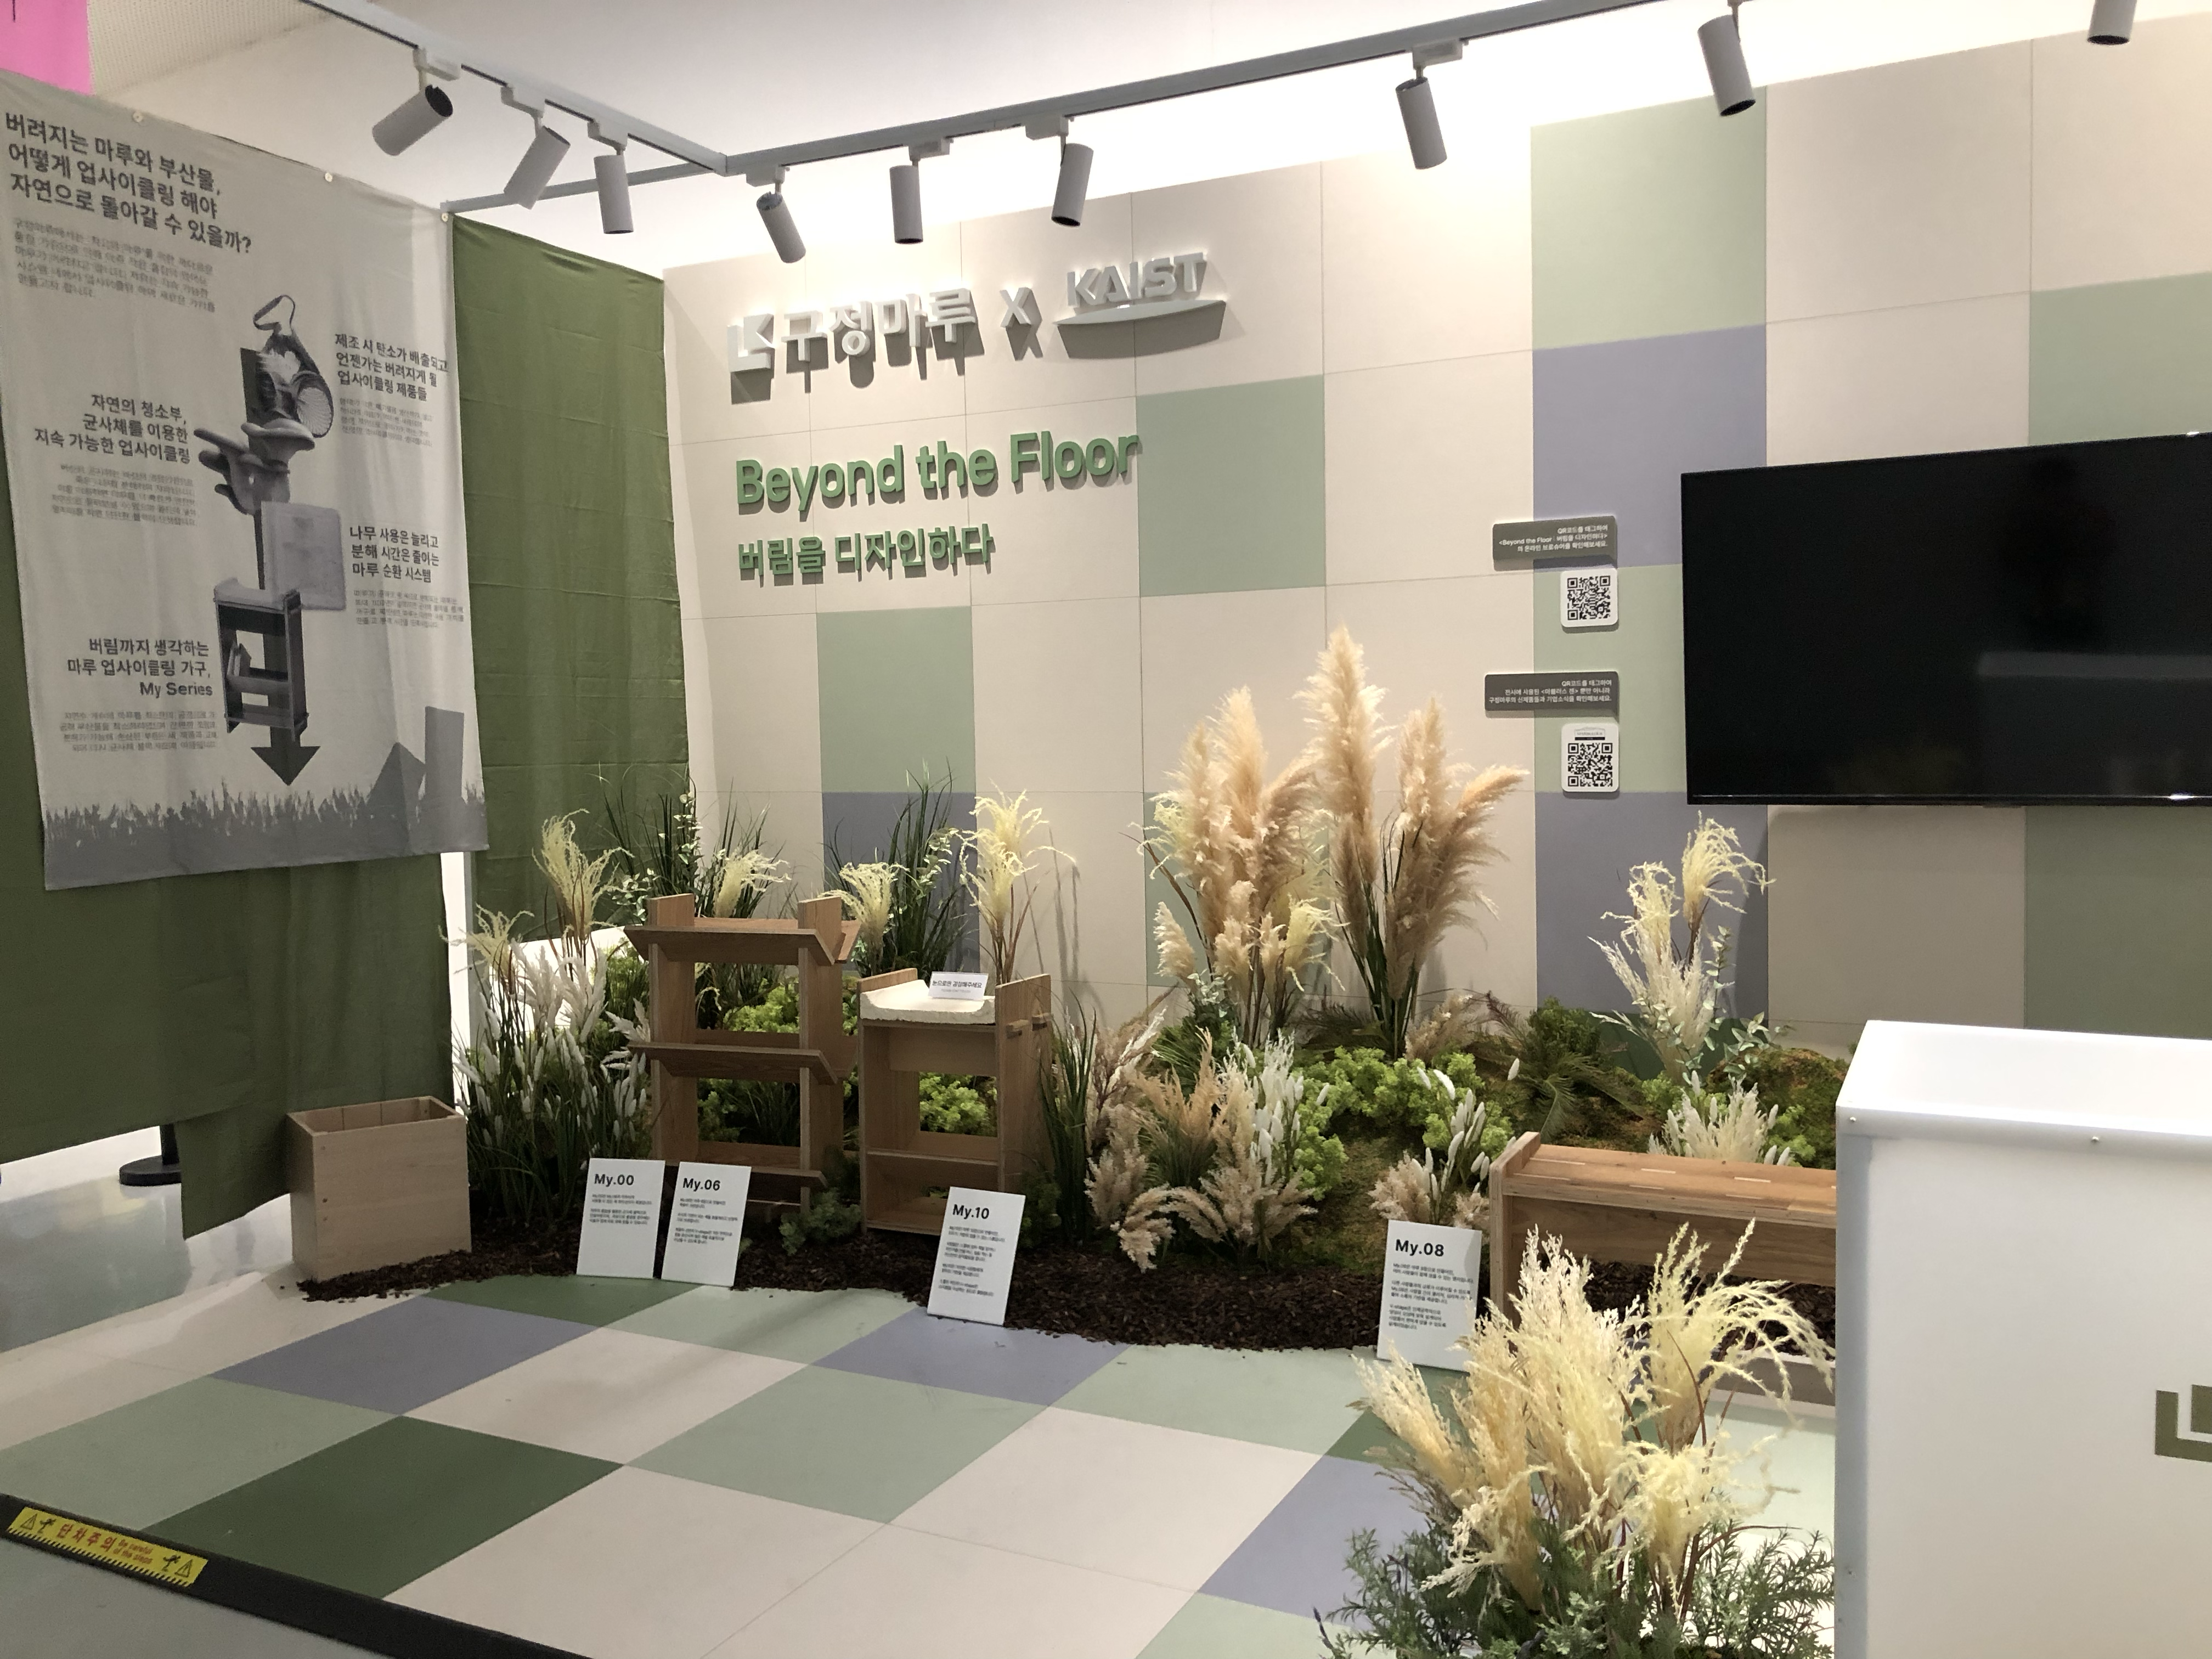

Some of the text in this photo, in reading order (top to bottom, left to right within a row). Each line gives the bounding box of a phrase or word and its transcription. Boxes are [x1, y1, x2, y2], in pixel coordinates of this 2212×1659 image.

[6, 113, 220, 195] 버려지는 마루와 부산물,
[9, 143, 217, 219] 어떻게 업사이클링 해야
[10, 173, 251, 253] 자연으로 돌아갈 수 있을까?
[781, 287, 977, 364] 구정마루
[1066, 252, 1208, 308] KAIST
[335, 334, 449, 373] 제조 시 탄소가 배출되고
[336, 352, 382, 373] 언젠가는
[385, 362, 426, 384] 버려지게
[337, 370, 427, 402] 업사이클링 제품들
[91, 394, 187, 425] 자연의 청소부,
[83, 414, 188, 444] 균사체를 이용한
[35, 428, 190, 465] 지속 가능한 업사이클링
[736, 431, 1139, 511] Beyond the Floor
[350, 525, 439, 549] 나무 사용은 늘리고
[738, 522, 995, 578] 버림을 디자인하다
[351, 544, 439, 567] 분해 시간은 줄이는
[352, 562, 431, 583] 마루 순환 시스템
[89, 638, 209, 657] 버림까지 생각하는
[67, 658, 211, 678] 마루 업사이클링 가구,
[139, 681, 213, 699] My Series
[594, 1173, 634, 1187] My.00
[683, 1178, 721, 1192] My.06
[953, 1204, 989, 1220] My.10
[1395, 1239, 1444, 1257] My.08
